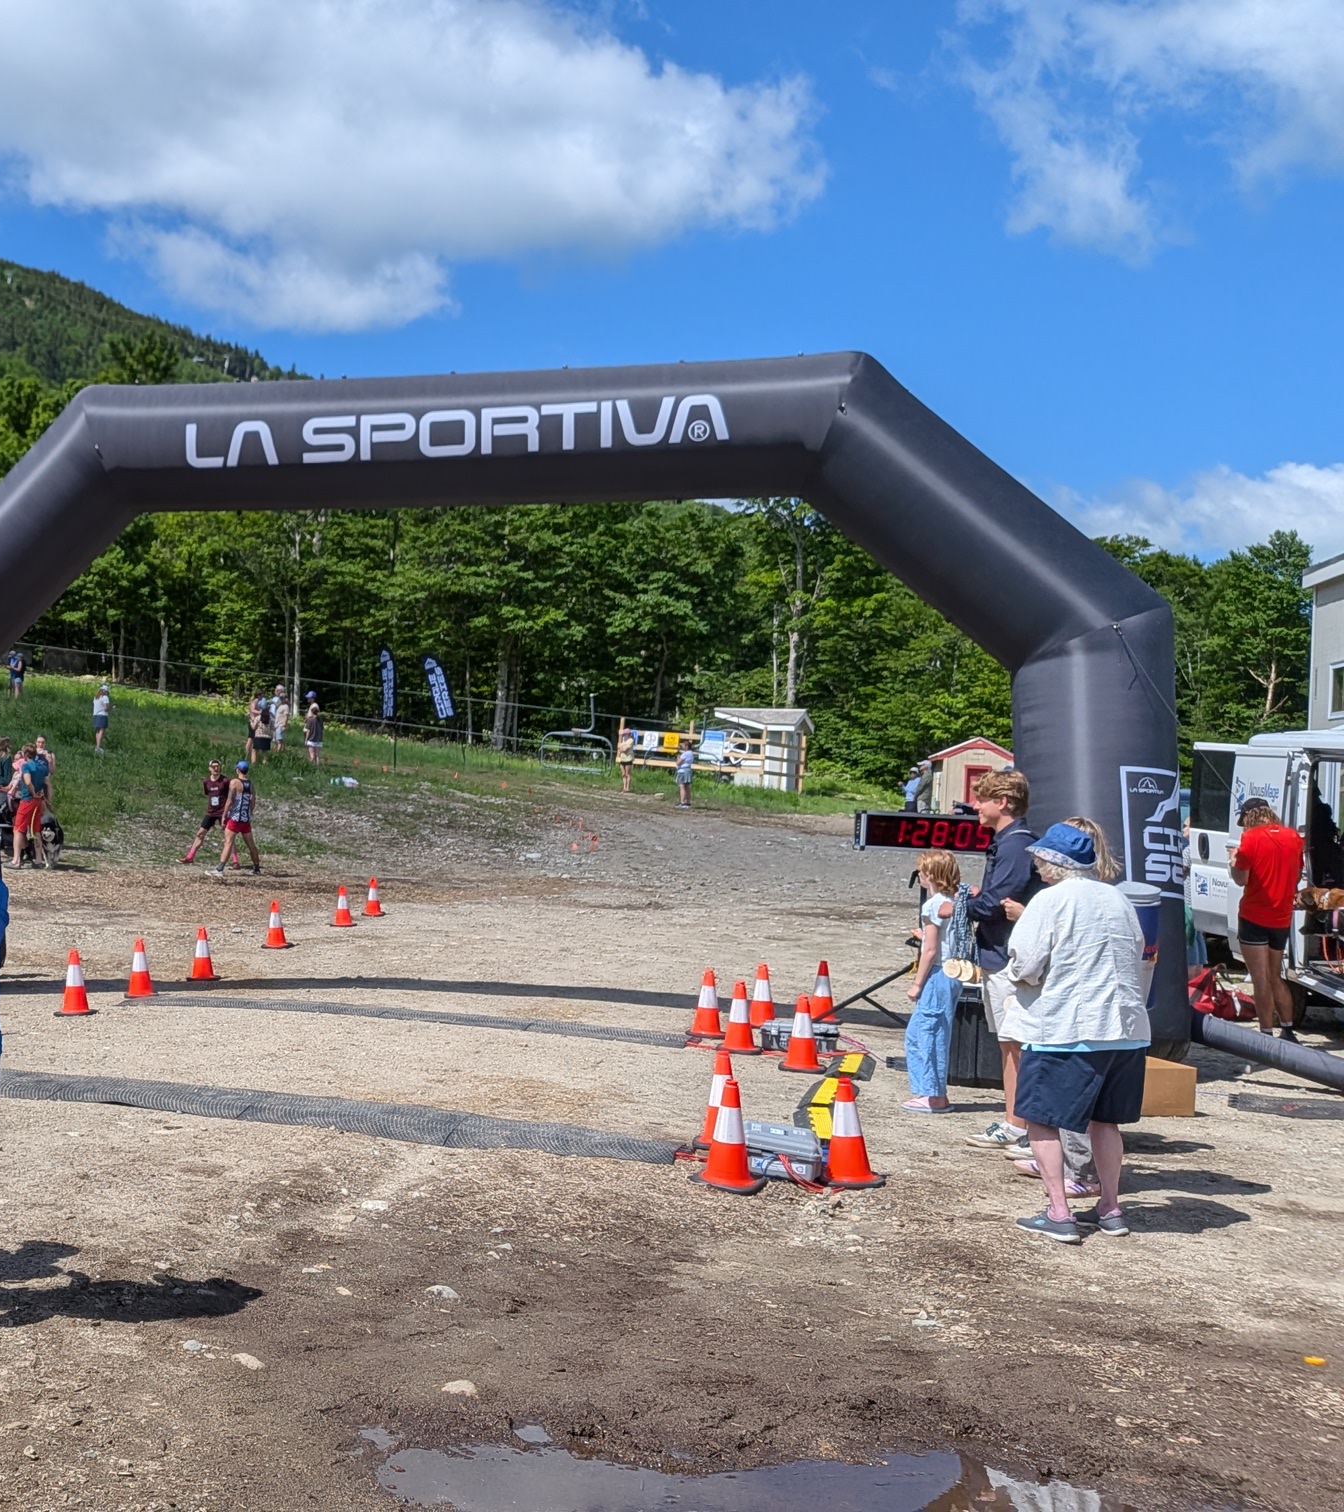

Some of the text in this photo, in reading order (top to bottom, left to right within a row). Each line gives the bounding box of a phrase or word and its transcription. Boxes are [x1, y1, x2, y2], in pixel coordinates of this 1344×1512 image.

[186, 394, 729, 468] LA SPORTIVA
[898, 820, 991, 848] 1:28:05
